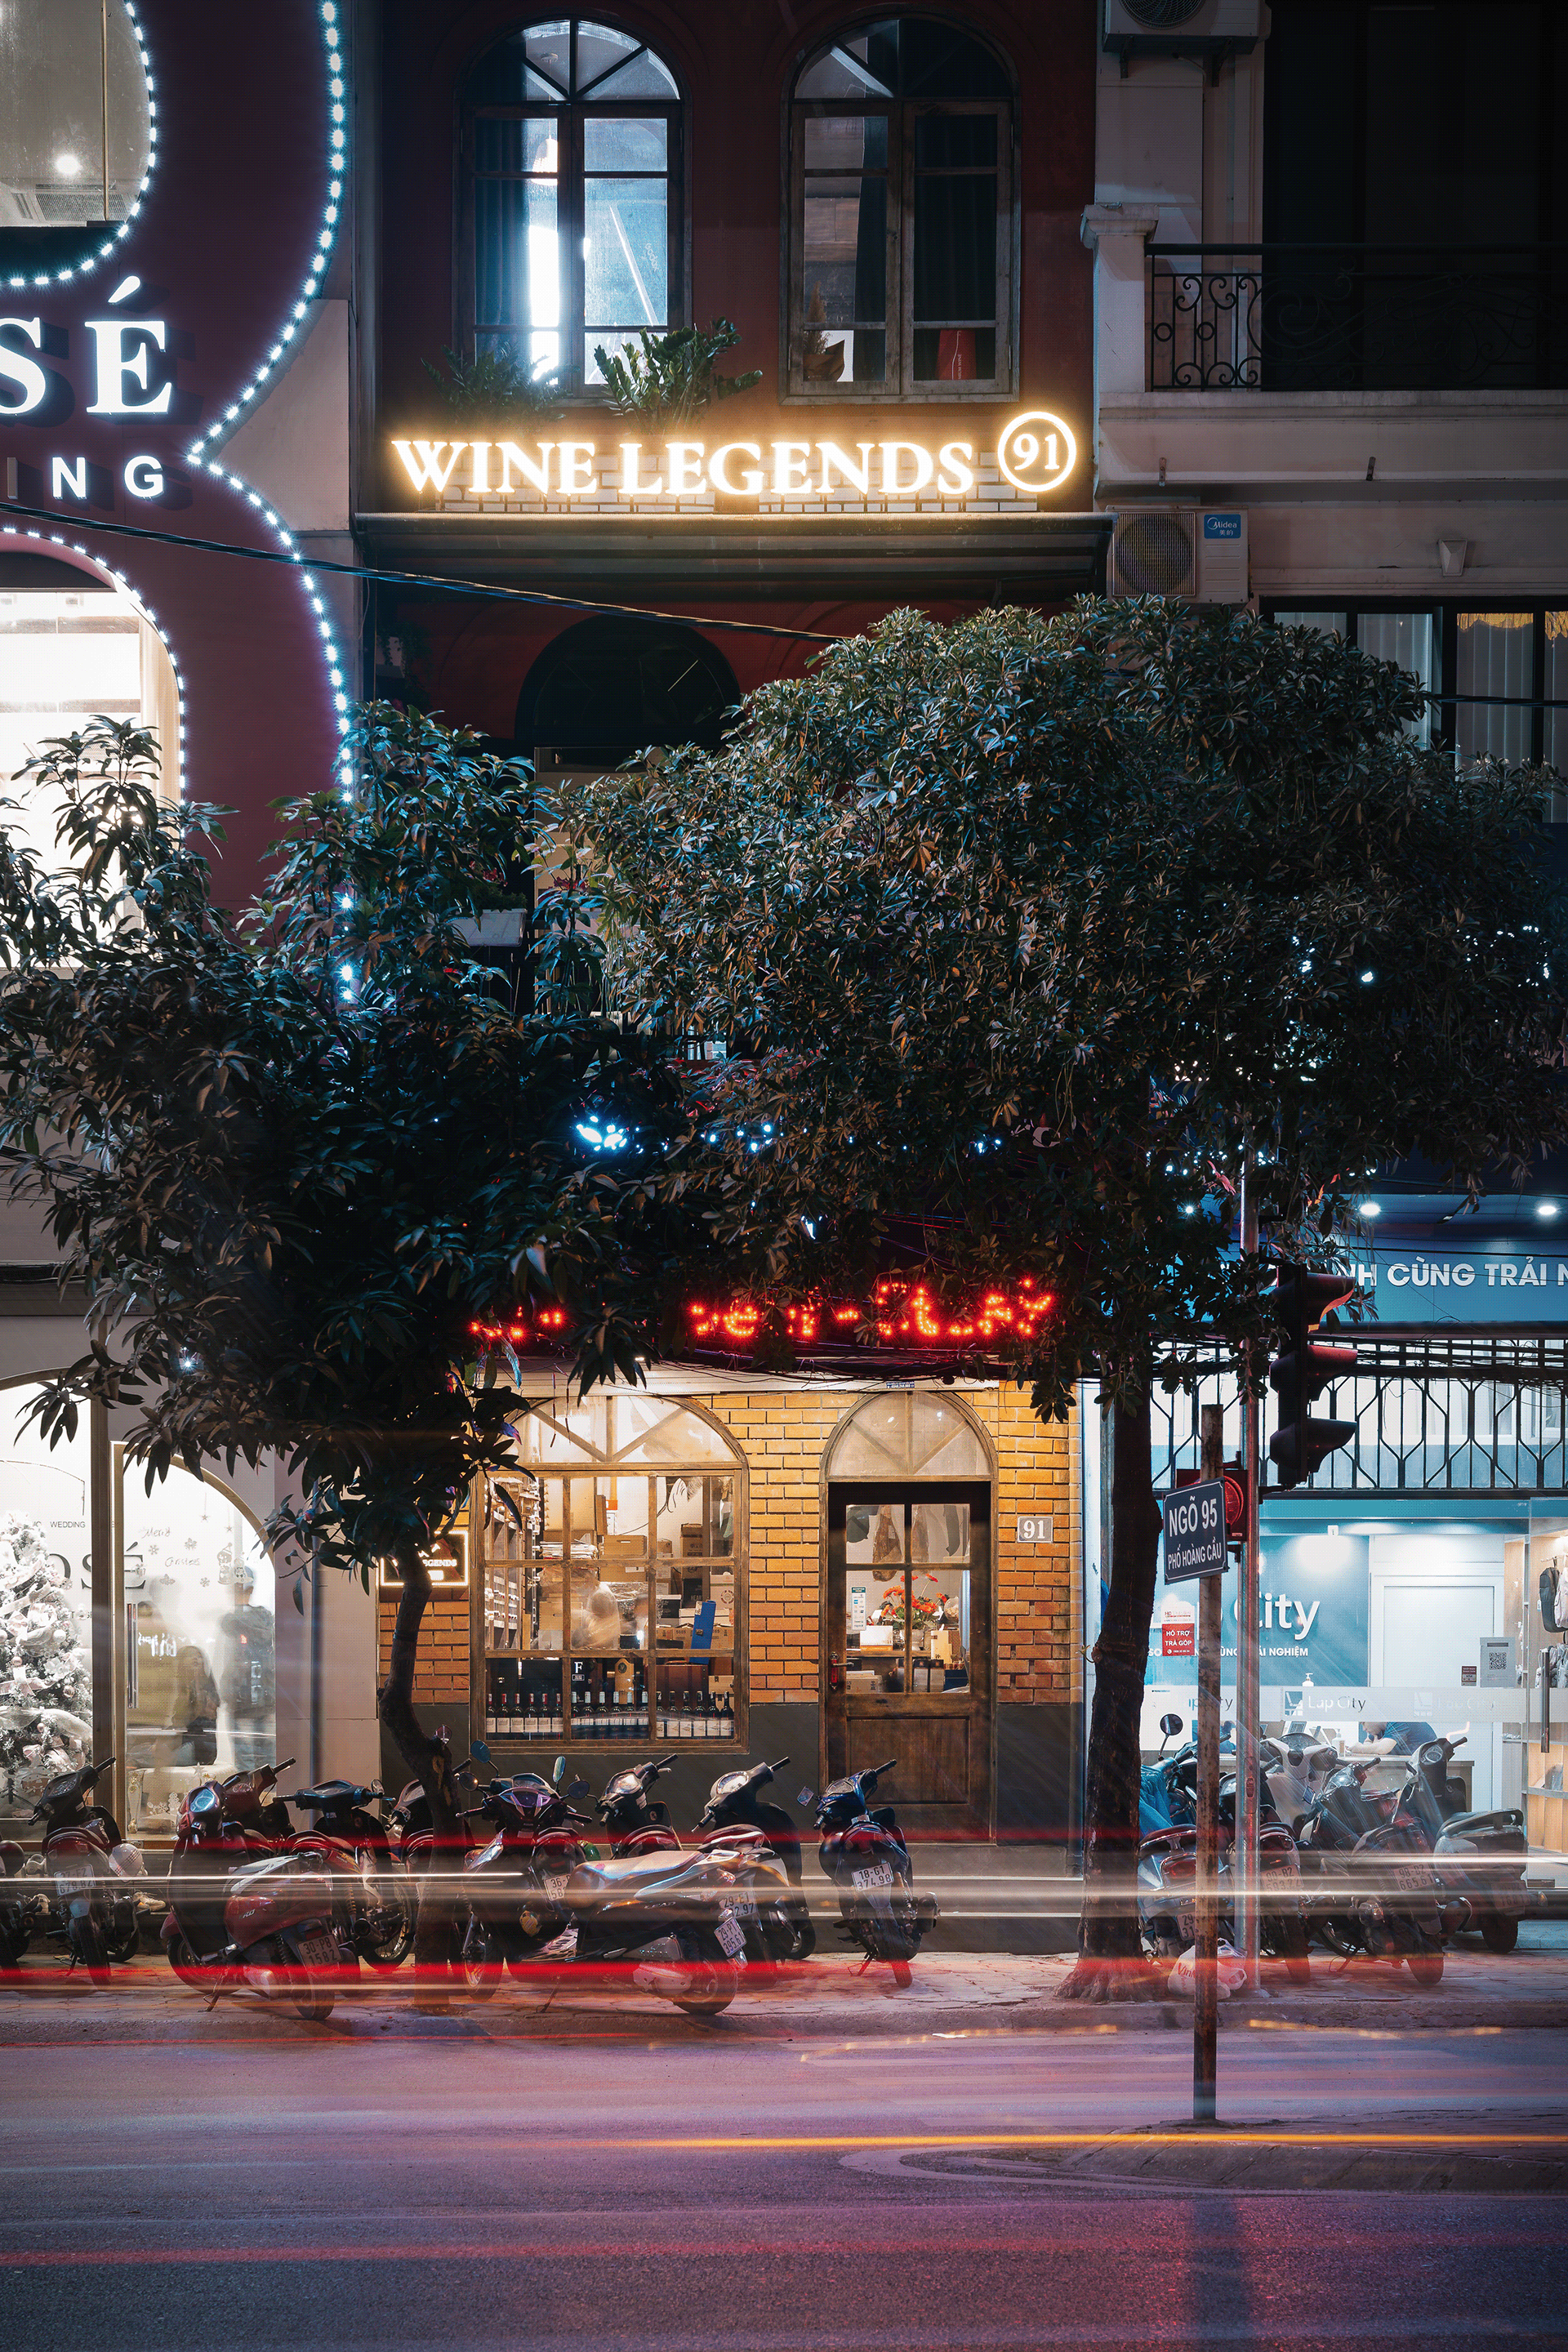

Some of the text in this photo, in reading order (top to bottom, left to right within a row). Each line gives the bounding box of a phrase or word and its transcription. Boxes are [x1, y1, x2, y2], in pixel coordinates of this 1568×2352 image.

[391, 431, 1061, 496] WINE LEGENDS 91
[1210, 519, 1237, 529] Midea
[1388, 1255, 1476, 1287] CÙNG
[1484, 1255, 1547, 1287] TRẢI
[1169, 1495, 1218, 1538] NGÕ 95
[1023, 1520, 1045, 1539] 91
[1168, 1536, 1222, 1570] PHỐ HOÀNG CẦU
[1234, 1592, 1321, 1641] ity
[1269, 1645, 1308, 1659] NGHIỆM
[574, 1661, 583, 1674] F
[1307, 1695, 1366, 1712] Lap City
[858, 1865, 884, 1879] 18-G1
[857, 1873, 891, 1891] 374.98
[303, 1936, 332, 1955] 30-P8
[308, 1949, 338, 1966] 1582
